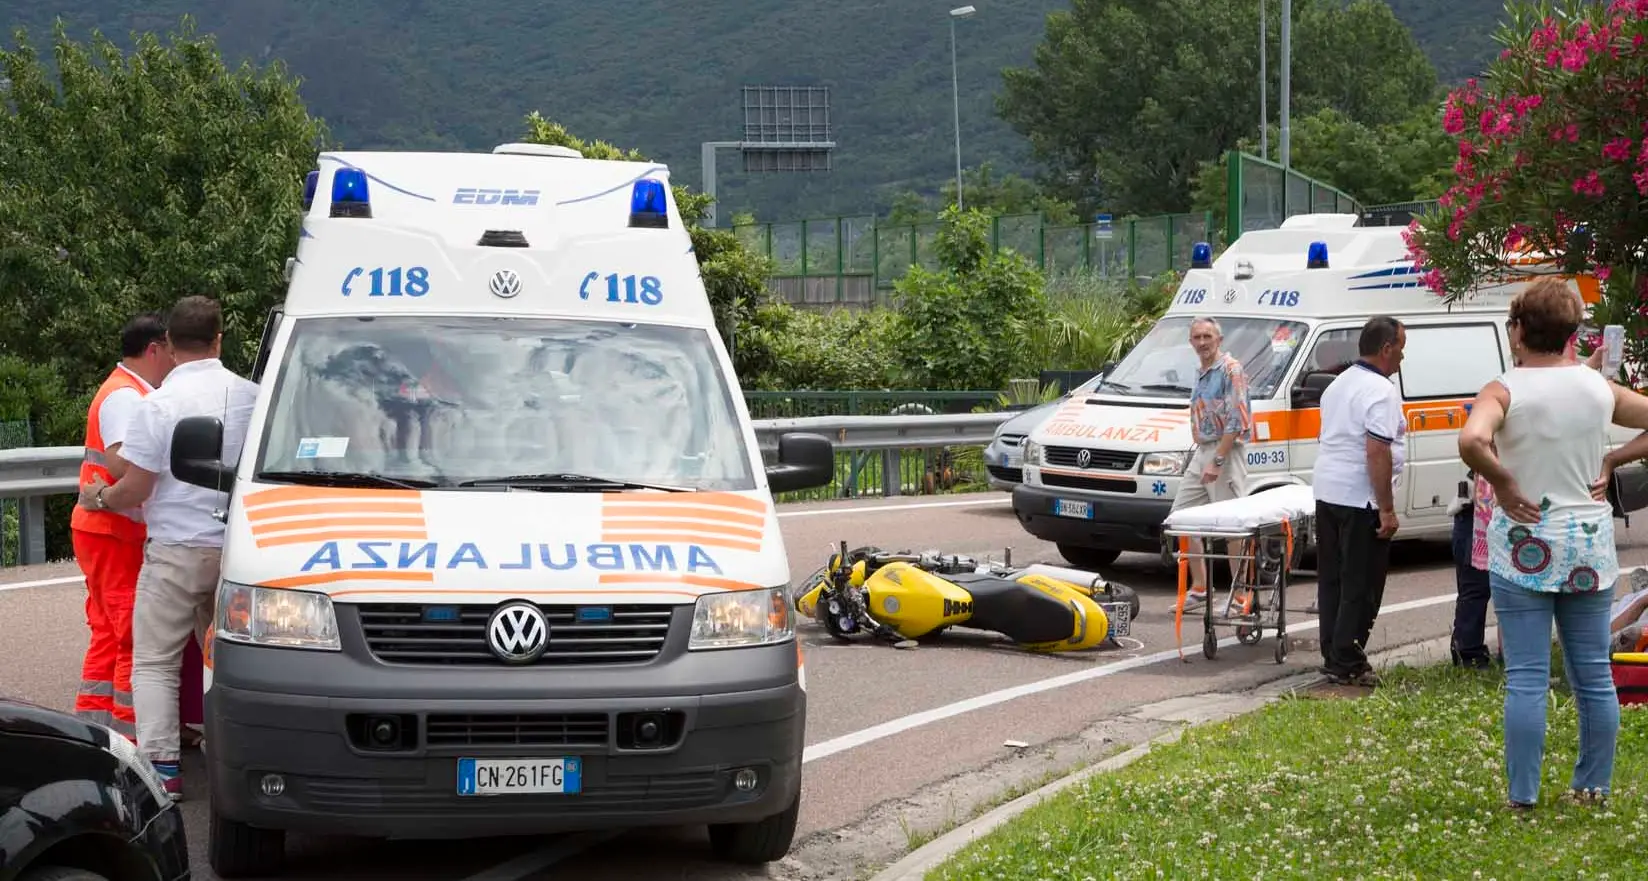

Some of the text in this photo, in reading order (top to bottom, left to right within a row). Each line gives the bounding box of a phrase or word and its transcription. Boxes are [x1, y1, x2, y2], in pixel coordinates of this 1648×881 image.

[452, 188, 541, 206] EDM
[368, 266, 430, 297] 118
[604, 273, 663, 305] 118
[1184, 289, 1207, 305] 118
[1269, 290, 1300, 307] 118
[1247, 450, 1285, 466] 009-33
